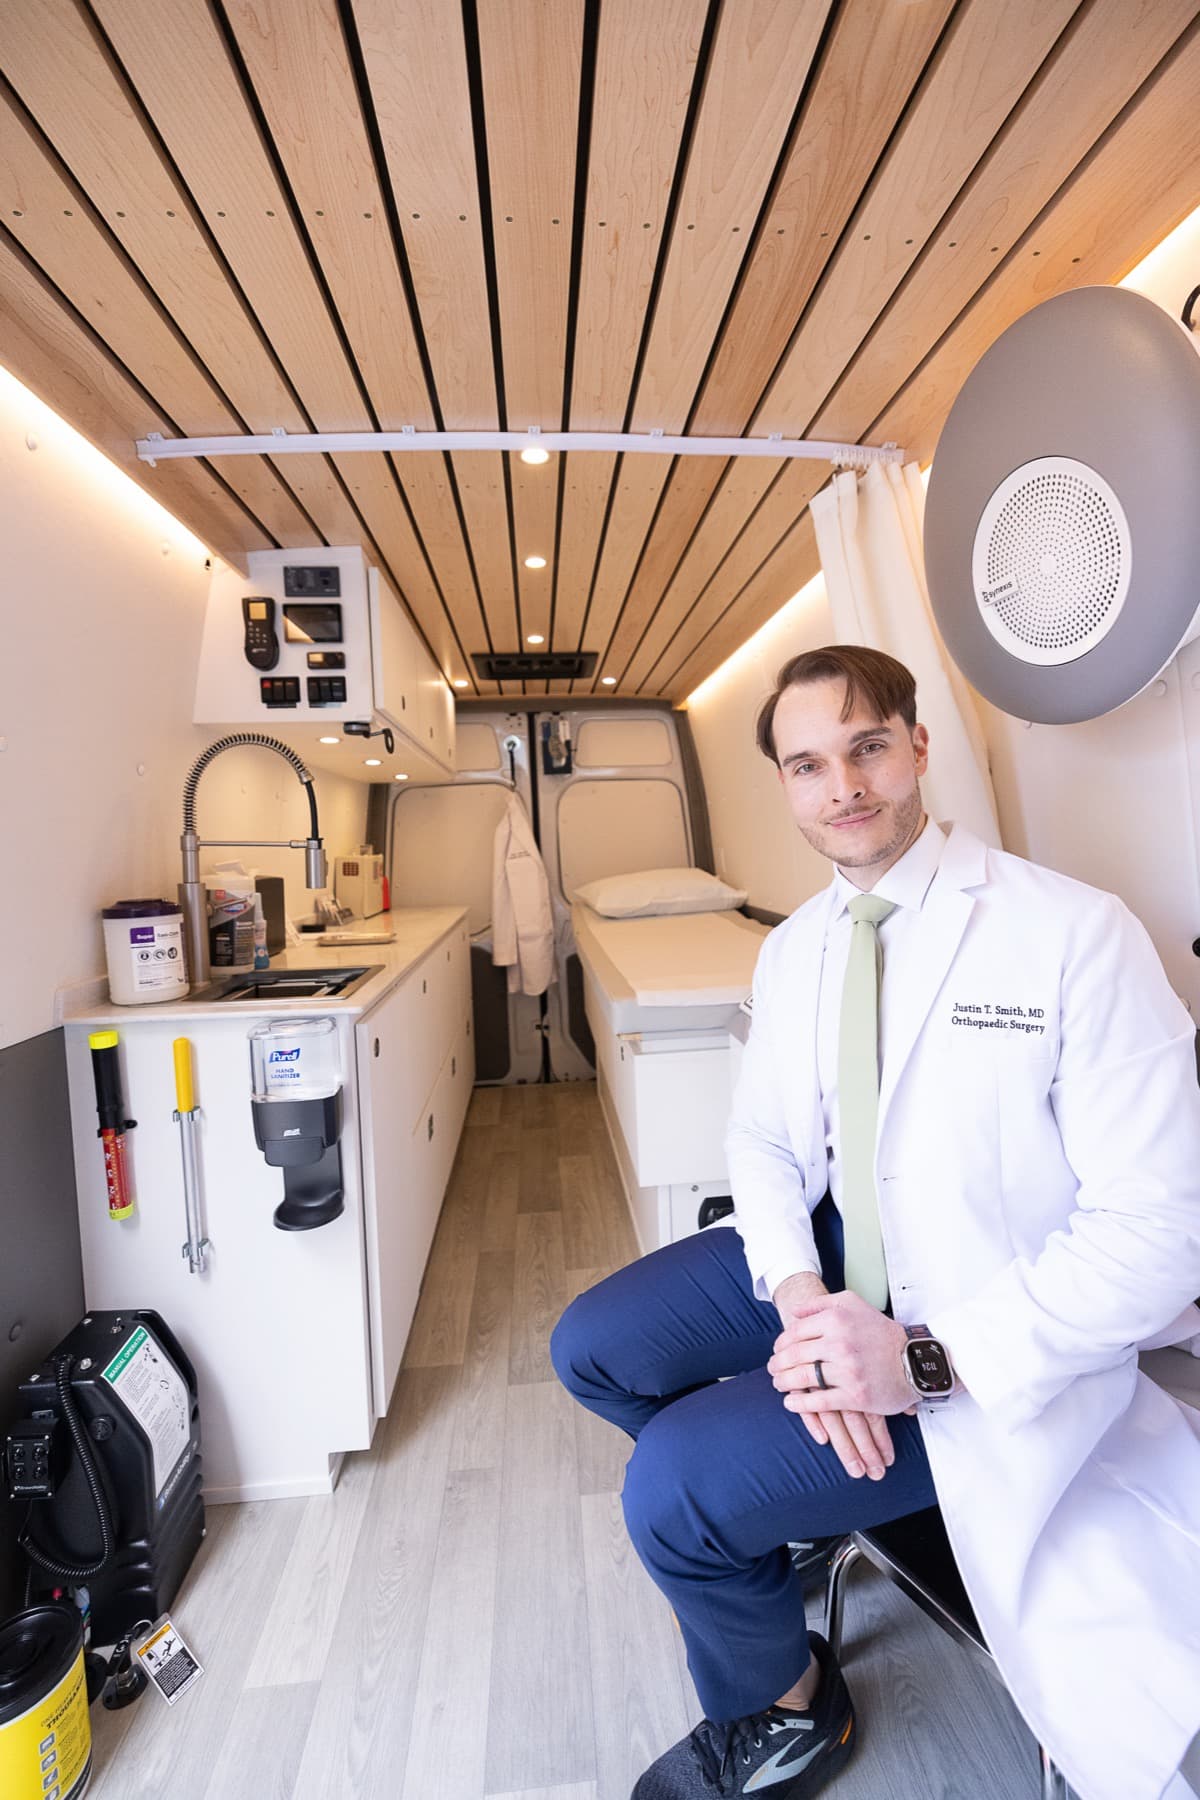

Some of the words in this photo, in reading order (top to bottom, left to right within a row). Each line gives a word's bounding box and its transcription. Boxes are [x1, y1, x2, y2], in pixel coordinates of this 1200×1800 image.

[988, 581, 1013, 598] synexis
[952, 1002, 982, 1014] Justin
[984, 1004, 993, 1015] T.
[995, 1005, 1027, 1018] Smith,
[1028, 1008, 1045, 1019] MD
[951, 1015, 1009, 1030] Orthopaedic
[1009, 1019, 1046, 1035] Surgery
[108, 1358, 125, 1379] MANUAL
[123, 1331, 146, 1359] OPERATION
